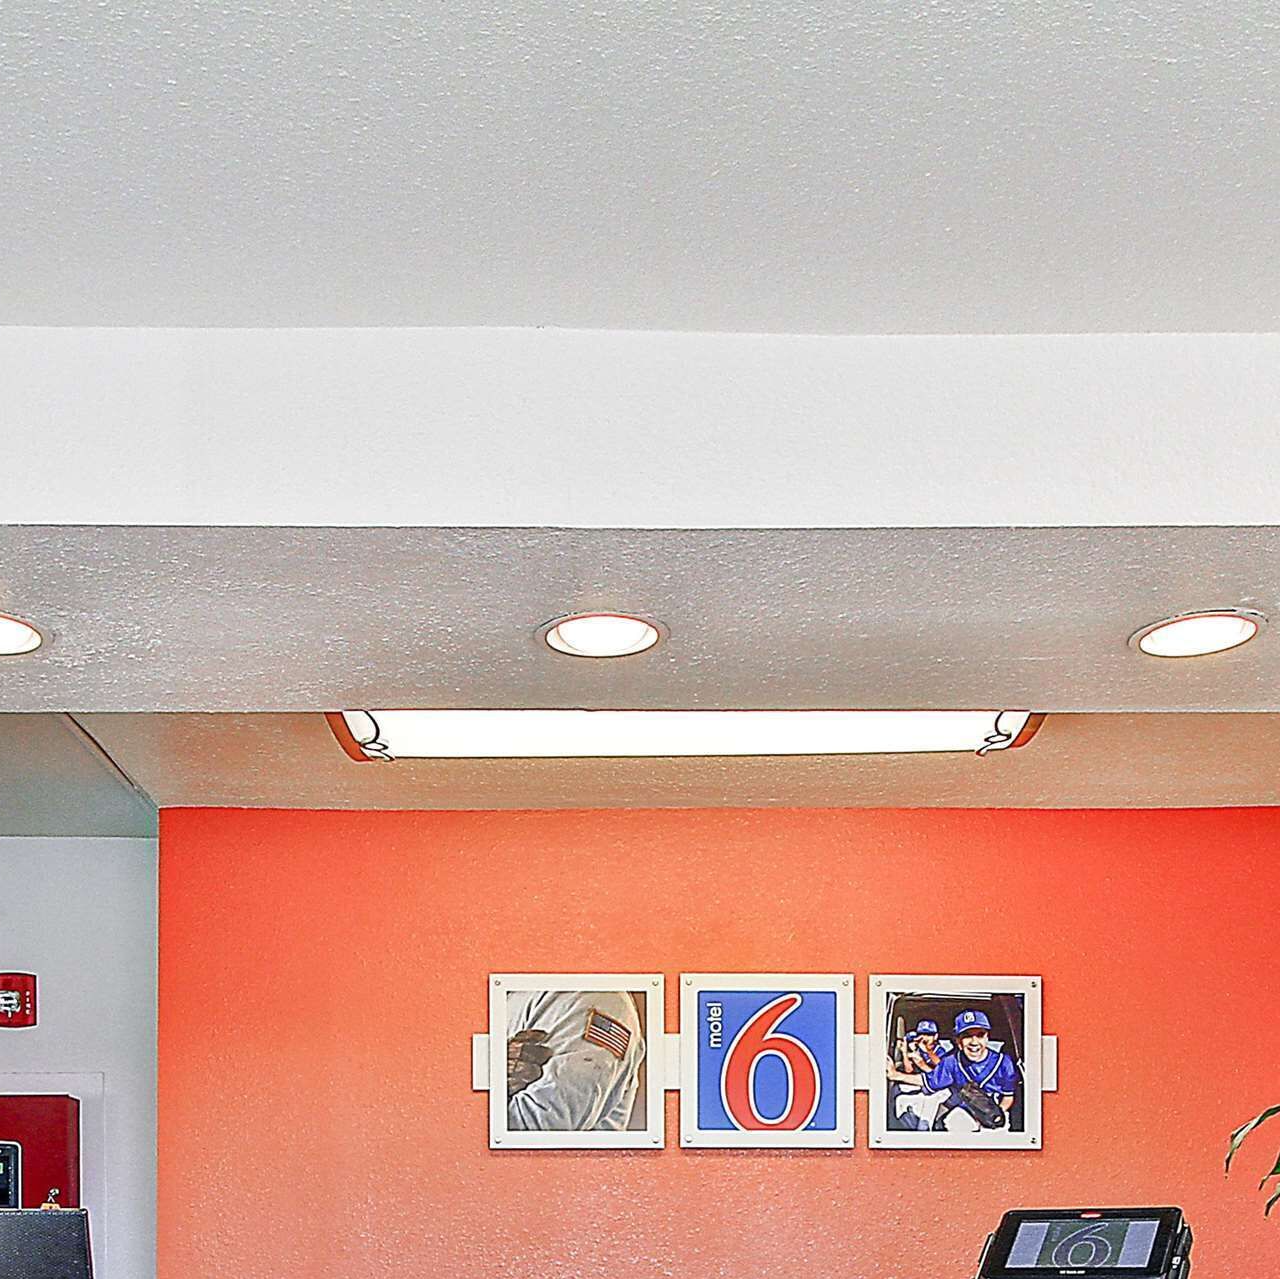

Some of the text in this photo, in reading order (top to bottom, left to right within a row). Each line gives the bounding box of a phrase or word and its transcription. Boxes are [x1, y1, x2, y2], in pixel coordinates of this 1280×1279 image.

[706, 992, 822, 1132] motel 6
[1051, 1222, 1112, 1268] 6
